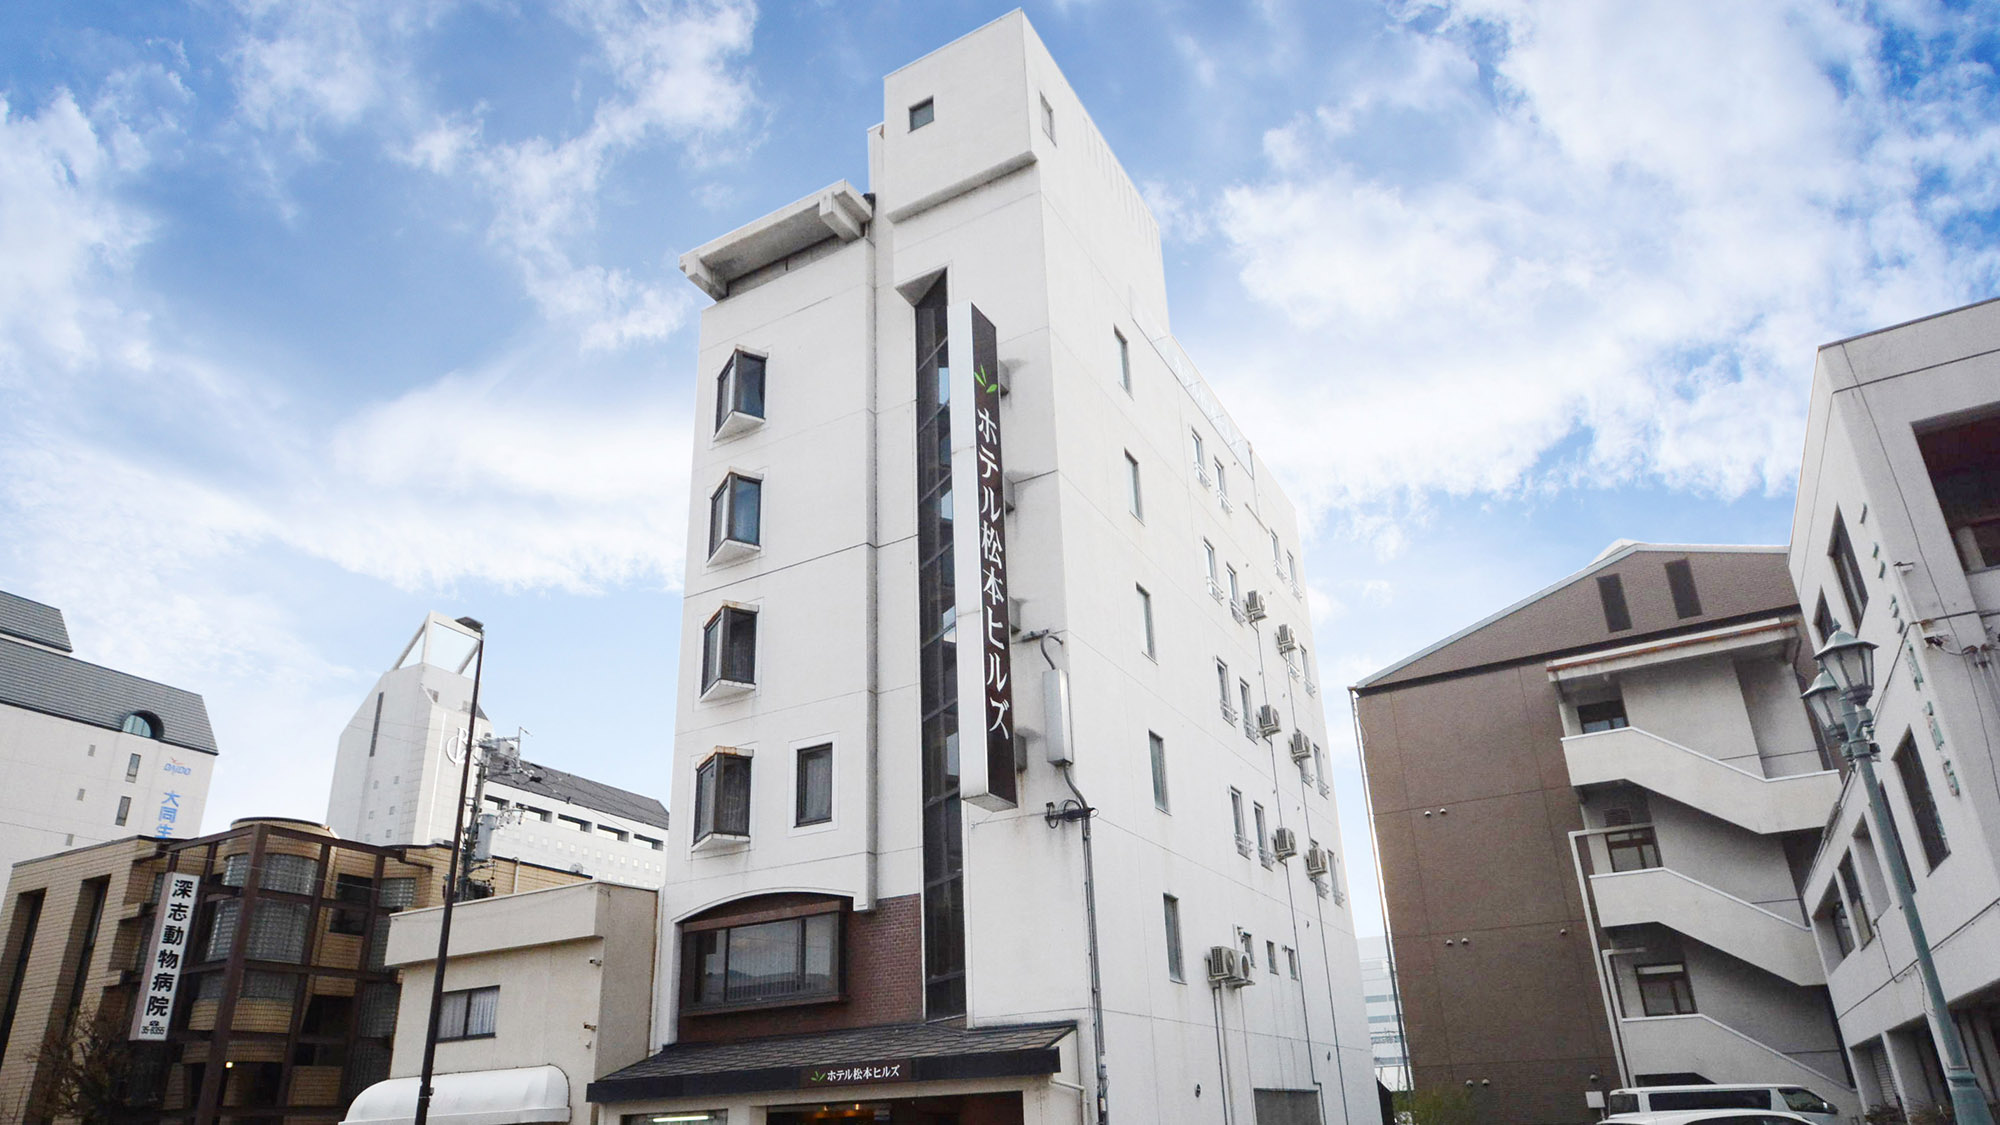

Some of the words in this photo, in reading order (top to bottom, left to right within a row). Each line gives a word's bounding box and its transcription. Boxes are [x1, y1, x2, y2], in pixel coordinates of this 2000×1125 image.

[978, 408, 1009, 740] ホテル松本ヒルズ
[146, 879, 193, 1016] 深志動物病院
[827, 1065, 900, 1082] ホテル松本ヒルズ
